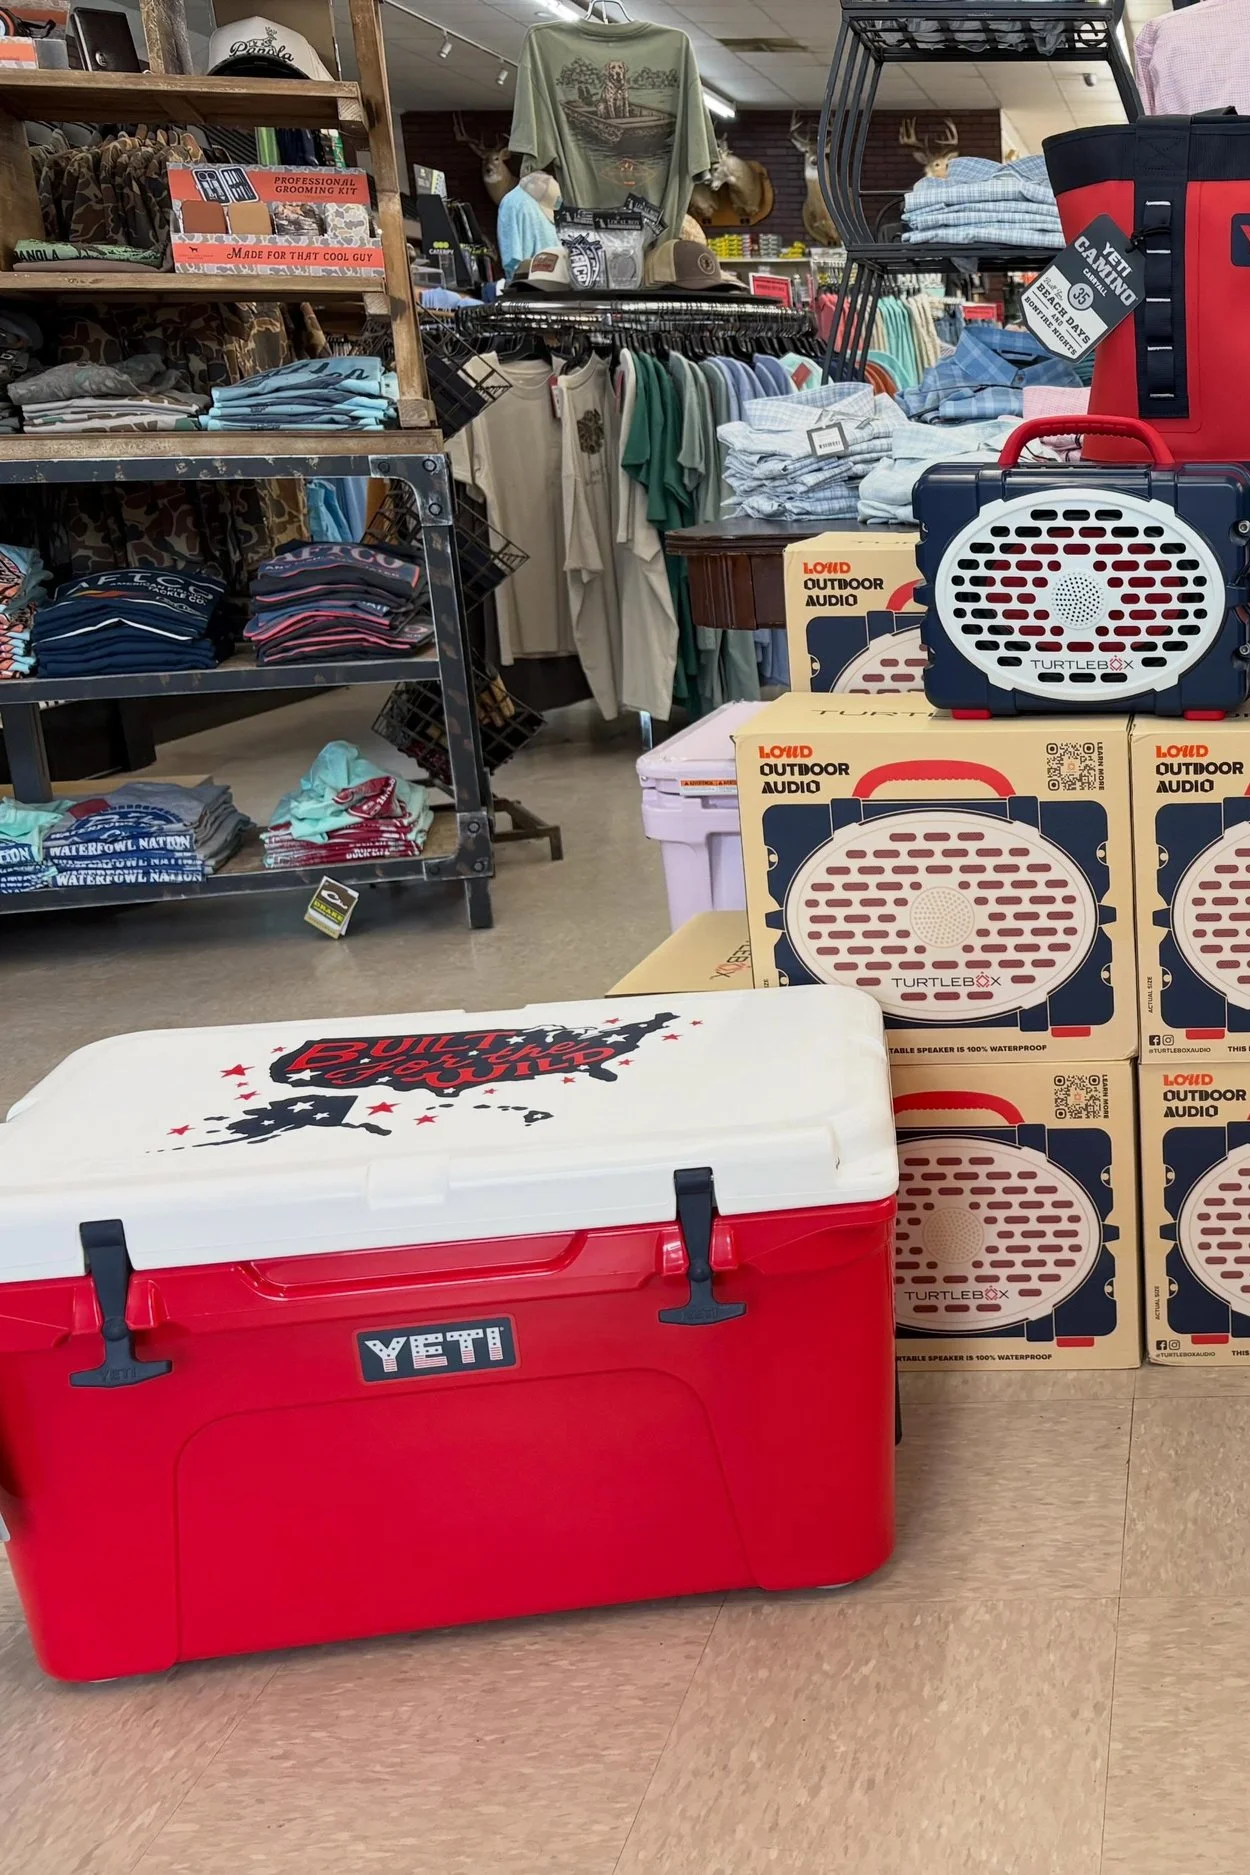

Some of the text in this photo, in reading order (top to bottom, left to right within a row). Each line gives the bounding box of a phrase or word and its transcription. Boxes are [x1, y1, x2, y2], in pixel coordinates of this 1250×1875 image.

[274, 176, 356, 187] PROFESSIONAL
[275, 185, 358, 195] GROOMING KIT
[267, 250, 286, 260] FOR
[289, 251, 320, 261] THAT
[323, 252, 349, 261] COOL
[352, 253, 373, 262] GUY
[1101, 241, 1133, 278] YETI
[1074, 235, 1137, 307] CAMINO
[1082, 267, 1108, 297] CARRYALL
[1073, 287, 1091, 306] 35
[1036, 282, 1091, 345] BEACH DAYS
[1051, 313, 1063, 327] AND
[1024, 295, 1078, 356] BONFIRE NIGHTS
[803, 562, 851, 575] LOUD
[66, 573, 214, 600] AFTCO
[803, 577, 884, 591] OUTDOOR
[148, 586, 187, 599] TACKLE
[805, 593, 858, 607] AUDIO
[1030, 656, 1134, 671] TURTLEBOX
[758, 745, 813, 759] LOUD
[1155, 744, 1209, 758] LOUD
[760, 762, 850, 776] OUTDOOR
[1096, 741, 1105, 791] LEARN MORE
[1156, 761, 1244, 776] OUTDOOR
[761, 779, 821, 794] AUDIO
[1156, 779, 1214, 793] AUDIO
[49, 835, 191, 857] WATERFOWL NATION
[56, 869, 147, 887] WATERFOWL
[891, 973, 1001, 988] TURTLEBOX
[287, 1031, 517, 1072] BUILT
[889, 1047, 914, 1055] TABLE
[916, 1046, 955, 1055] SPEAKER
[989, 1044, 1047, 1053] WATERPROOF
[1227, 1045, 1247, 1053] THIS
[324, 1041, 591, 1085] for the
[400, 1048, 616, 1088] WILD
[1163, 1074, 1213, 1086] LOUD
[1163, 1089, 1247, 1102] OUTDOOR
[1163, 1104, 1218, 1118] AUDIO
[904, 1286, 1009, 1300] TURTLEBOX
[364, 1327, 504, 1373] YETI
